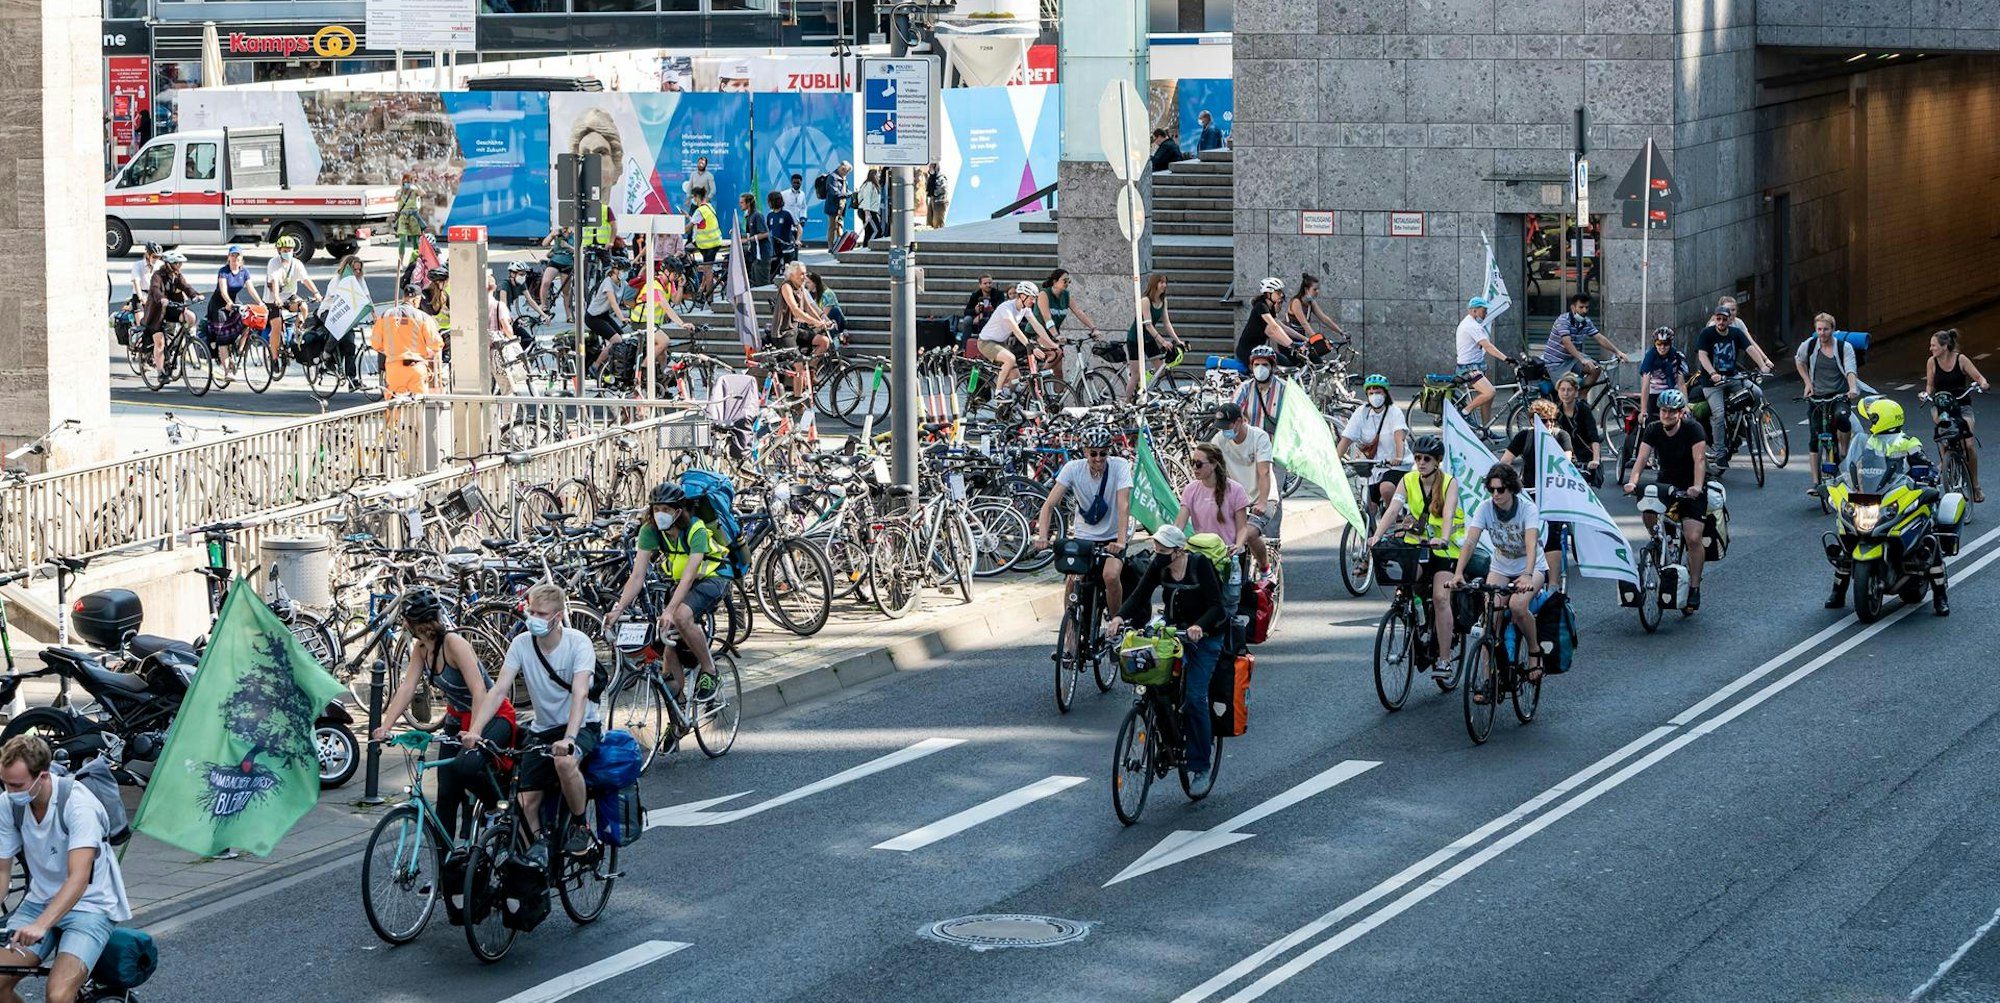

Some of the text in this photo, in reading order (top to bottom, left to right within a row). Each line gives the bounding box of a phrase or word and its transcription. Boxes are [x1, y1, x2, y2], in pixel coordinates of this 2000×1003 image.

[103, 34, 126, 46] ne
[229, 32, 310, 57] Kamps
[788, 73, 851, 89] ZÜBLIN
